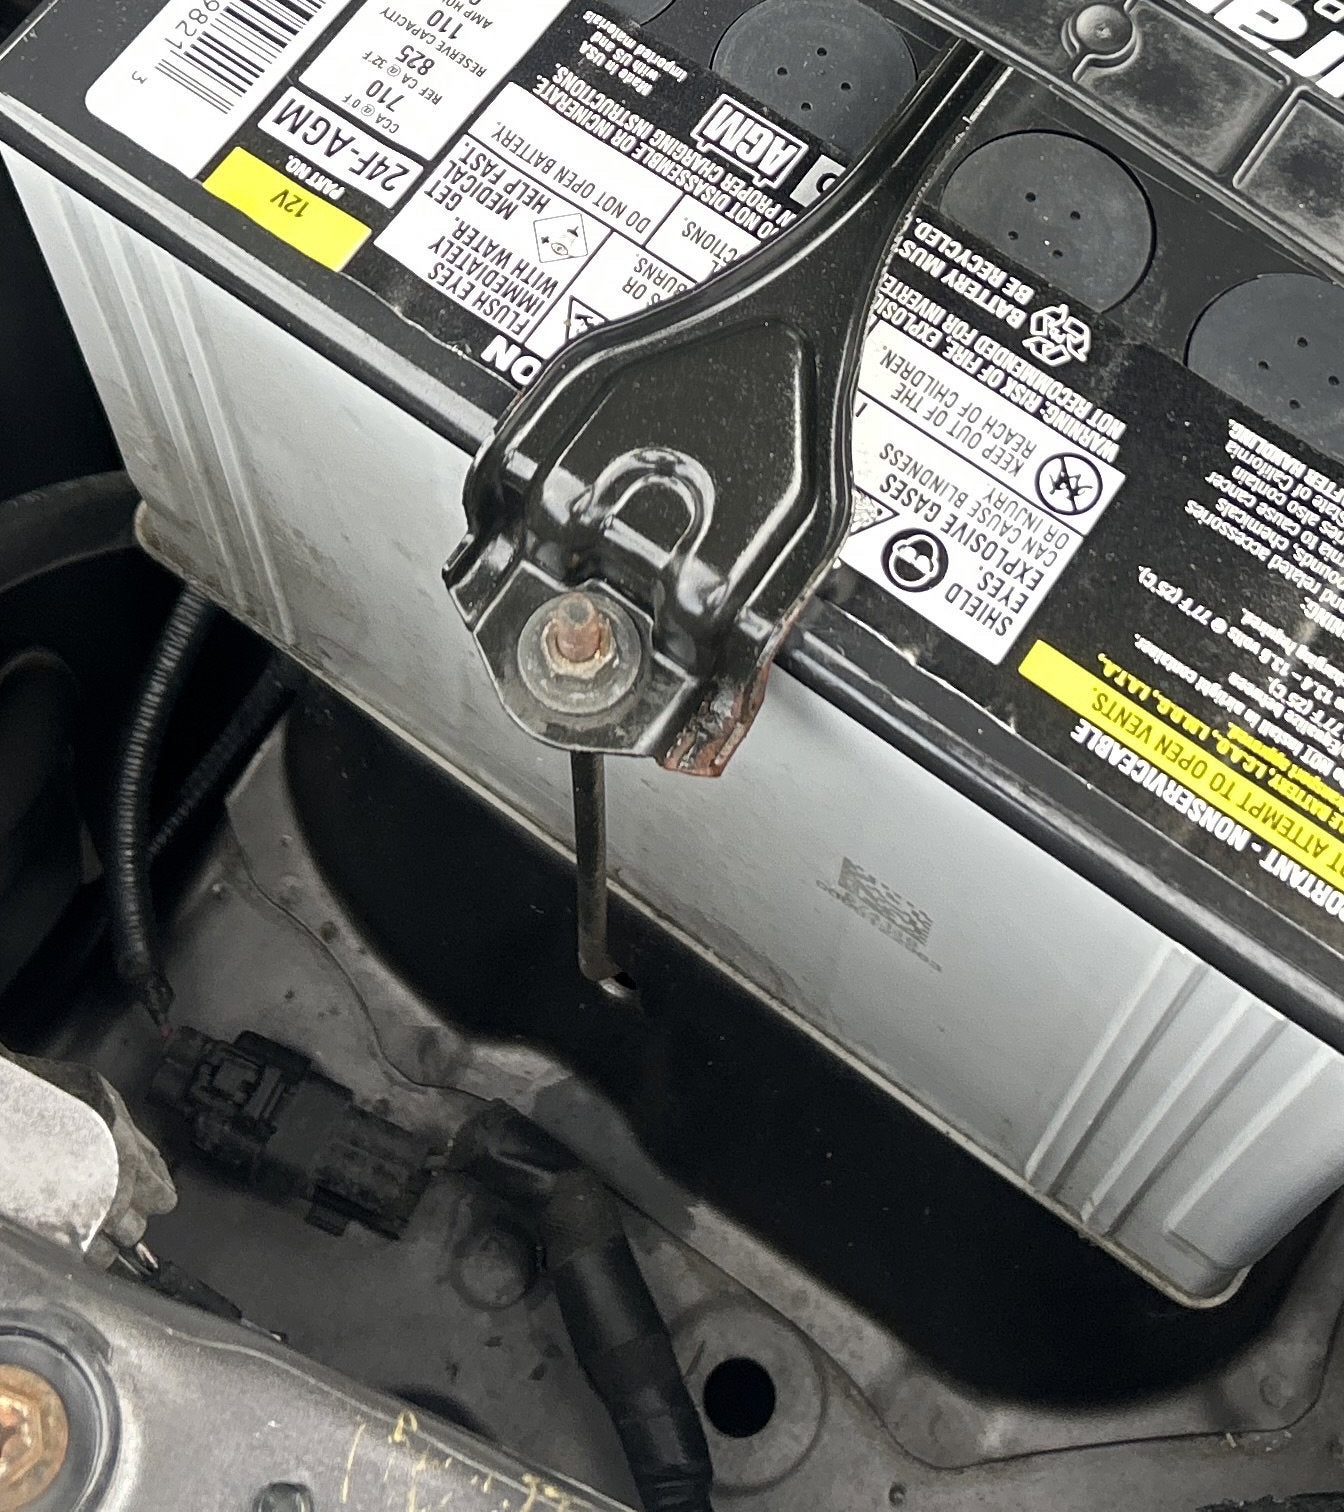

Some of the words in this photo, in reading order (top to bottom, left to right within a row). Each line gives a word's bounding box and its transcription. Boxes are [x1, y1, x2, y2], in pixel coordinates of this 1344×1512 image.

[378, 4, 438, 45] CAPACITY
[422, 6, 468, 41] 110
[460, 5, 494, 30] AMP
[577, 6, 640, 51] materials
[393, 41, 439, 77] 825
[432, 38, 489, 78] RESERVE
[575, 39, 610, 66] USA
[586, 29, 619, 54] and
[610, 45, 636, 65] US
[629, 39, 691, 83] imported
[128, 68, 149, 85] 3
[383, 62, 404, 79] @
[397, 71, 421, 91] CA
[600, 57, 622, 75] in
[613, 65, 656, 97] Made
[627, 56, 663, 84] with
[356, 101, 377, 119] @
[360, 76, 408, 113] 710
[415, 83, 444, 106] REF
[524, 72, 619, 138] INCINERATE.
[543, 60, 658, 139] INSTRUCTIONS.
[371, 111, 402, 135] CCA
[607, 125, 637, 151] OR
[698, 101, 802, 180] AGM
[268, 93, 412, 197] 24F-AGM
[450, 140, 510, 185] FAST.
[483, 119, 560, 175] BATTERY.
[645, 125, 728, 184] CHARGING
[279, 152, 314, 179] NO.
[304, 168, 347, 201] PART
[552, 163, 599, 199] OPEN
[629, 139, 735, 213] DISASSEMBLE
[268, 184, 313, 220] 12V
[421, 176, 466, 213] GET
[434, 157, 522, 220] MEDICAL
[500, 174, 553, 214] HELP
[591, 188, 629, 219] NOT
[717, 170, 785, 219] PROPER
[621, 208, 652, 234] DO
[723, 198, 763, 230] NOT
[442, 214, 516, 269] WATER.
[904, 214, 1011, 288] RECYCLED.
[425, 232, 547, 318] IMMEDIATELY
[425, 259, 477, 300] EYES
[507, 256, 562, 299] WITH
[618, 274, 650, 301] OR
[999, 274, 1037, 307] BE
[468, 288, 531, 337] FLUSH
[937, 264, 1029, 330] BATTERY
[937, 311, 981, 347] FOR
[934, 334, 985, 374] FIRE,
[870, 343, 963, 410] CHILDREN.
[969, 331, 1095, 418] RECOMMENDED
[973, 359, 1007, 390] OF
[997, 375, 1045, 414] RISK
[887, 381, 928, 414] THE
[920, 401, 951, 429] OF
[954, 397, 985, 425] OF
[945, 417, 985, 451] OUT
[978, 413, 1039, 460] REACH
[1033, 397, 1124, 464] WARNING:
[1084, 404, 1129, 440] NOT
[875, 439, 971, 509] BLINDNESS
[978, 438, 1027, 478] KEEP
[875, 470, 944, 524] GASES
[1203, 467, 1259, 510] cancer
[1227, 462, 1289, 509] contain
[964, 497, 1025, 545] CAUSE
[1179, 497, 1272, 563] accessories
[1209, 495, 1292, 554] chemicals
[1252, 499, 1304, 538] cause
[1282, 497, 1322, 530] also
[937, 510, 1047, 591] EXPLOSIVE
[1019, 534, 1060, 569] CAN
[1040, 522, 1072, 551] OR
[1296, 527, 1321, 551] to
[966, 563, 1031, 615] EYES.
[1264, 551, 1323, 597] related
[941, 579, 1016, 638] SHIELD
[1080, 684, 1159, 746] VENTS.
[1150, 731, 1212, 782] OPEN
[1065, 715, 1255, 852] NONSERVICEABLE
[1203, 766, 1240, 800] TO
[1233, 786, 1331, 861] ATTEMPT
